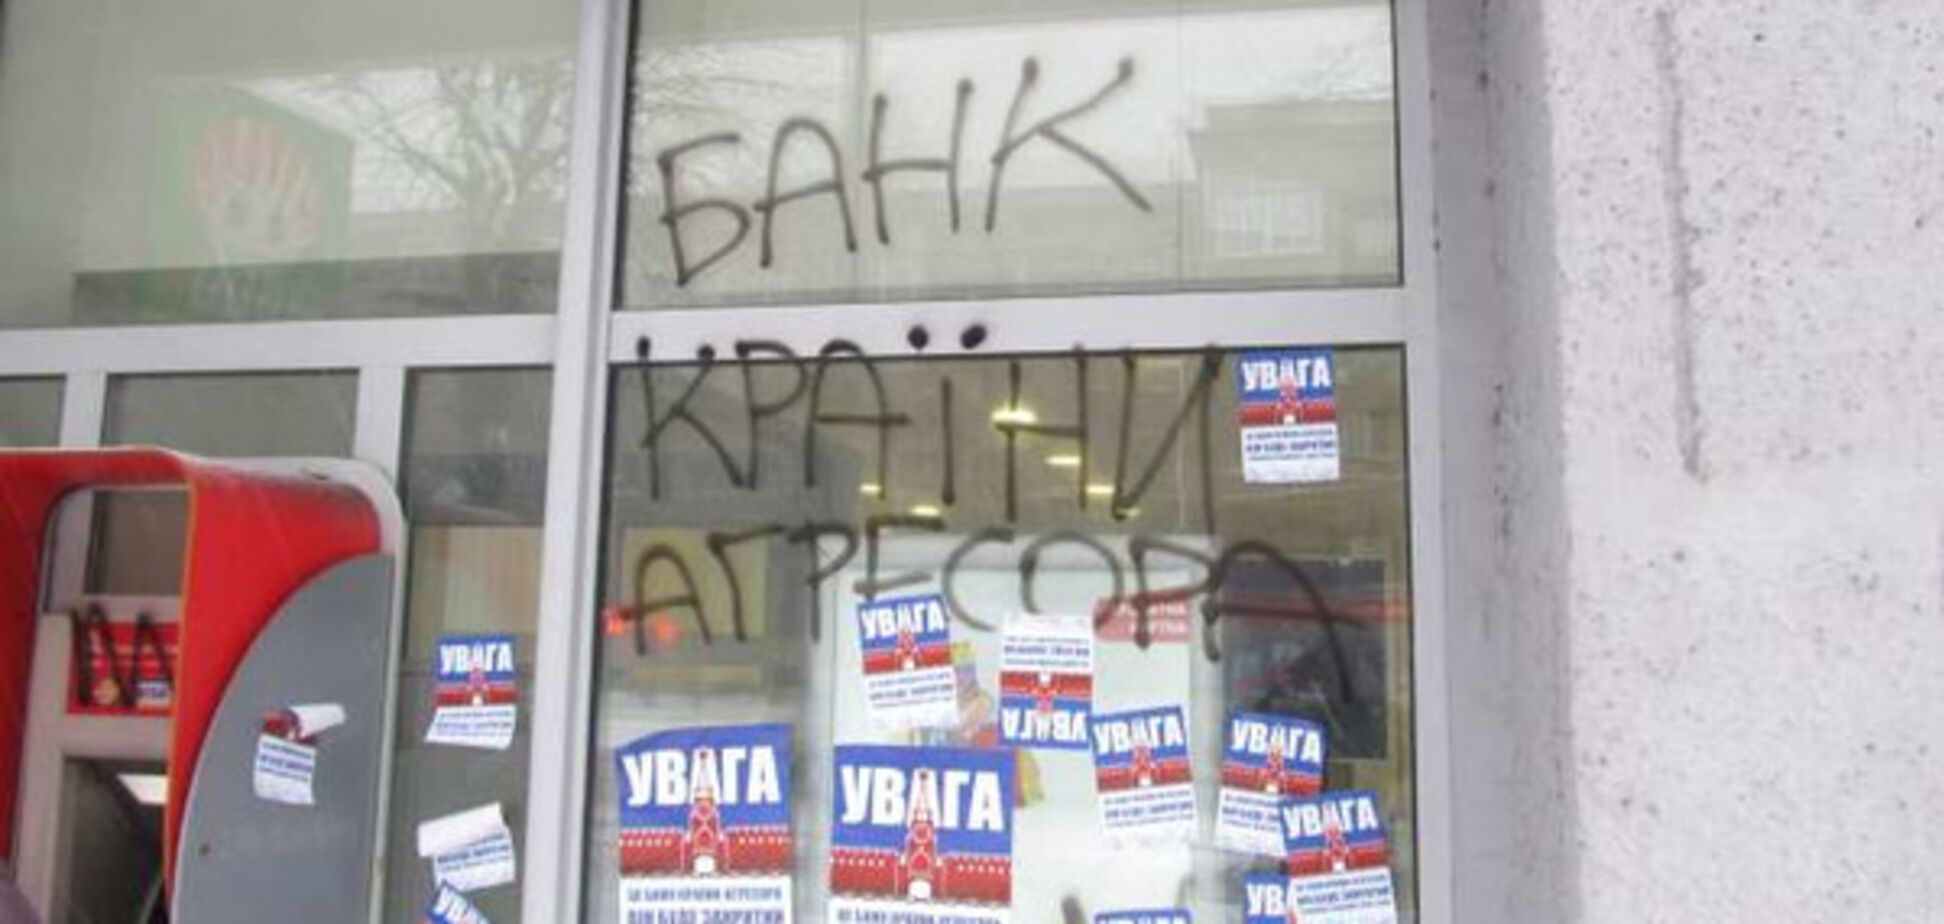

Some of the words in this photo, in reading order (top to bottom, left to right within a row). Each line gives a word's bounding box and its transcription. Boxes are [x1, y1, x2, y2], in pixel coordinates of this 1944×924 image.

[658, 56, 1153, 287] БАНК
[1241, 357, 1331, 392] УВАГА
[635, 323, 1226, 530] КРАЇНИ
[617, 515, 1363, 705] АГРЕСОРА
[861, 599, 945, 639] УВАГА
[439, 641, 514, 675] УВАГА
[1001, 708, 1088, 743] УВАГА
[1093, 712, 1185, 755] УВАГА
[1231, 718, 1322, 764] УВАГА
[621, 744, 782, 807] УВАГА
[840, 764, 1004, 832] УВАГА
[1282, 795, 1380, 840] УВАГА
